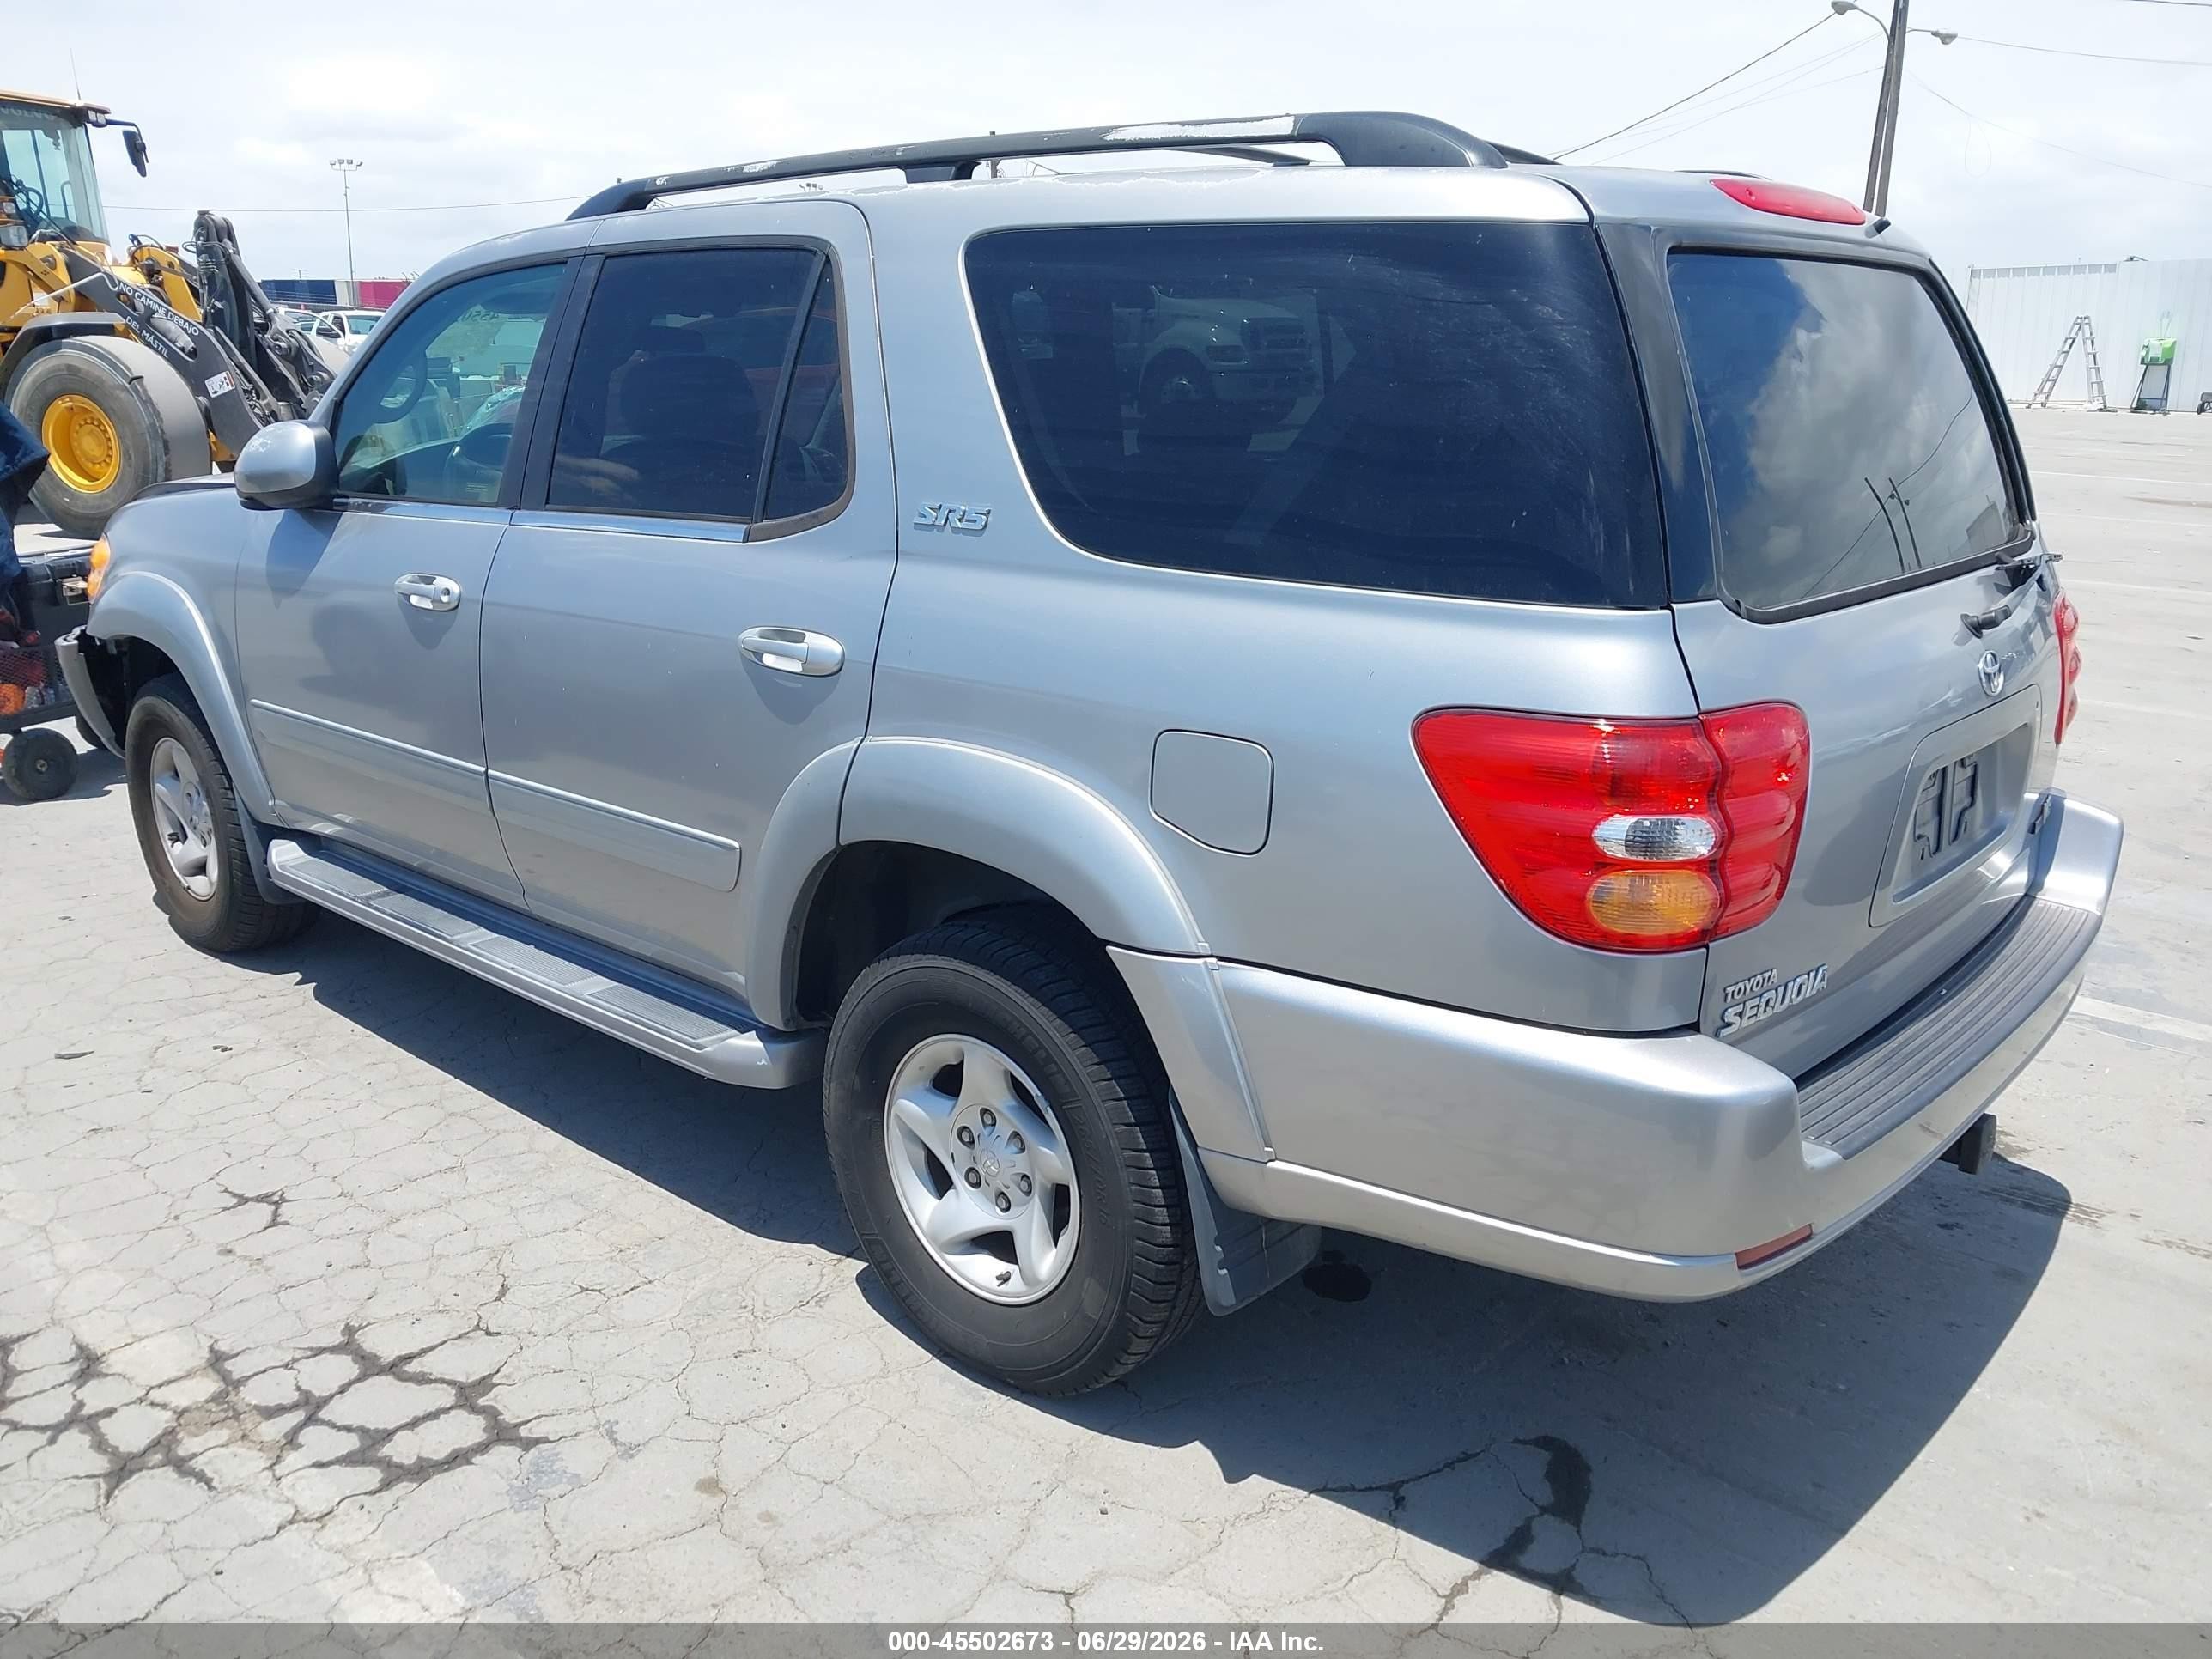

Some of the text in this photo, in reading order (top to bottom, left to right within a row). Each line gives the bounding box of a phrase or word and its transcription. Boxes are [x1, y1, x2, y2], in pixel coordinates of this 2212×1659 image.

[119, 282, 199, 336] NO CAMINE DEBAJO
[125, 315, 168, 358] DEL MÁSTIL
[913, 502, 992, 533] SR5
[1716, 963, 1828, 1037] SEQUOIA
[1724, 968, 1778, 1003] TOYOTA
